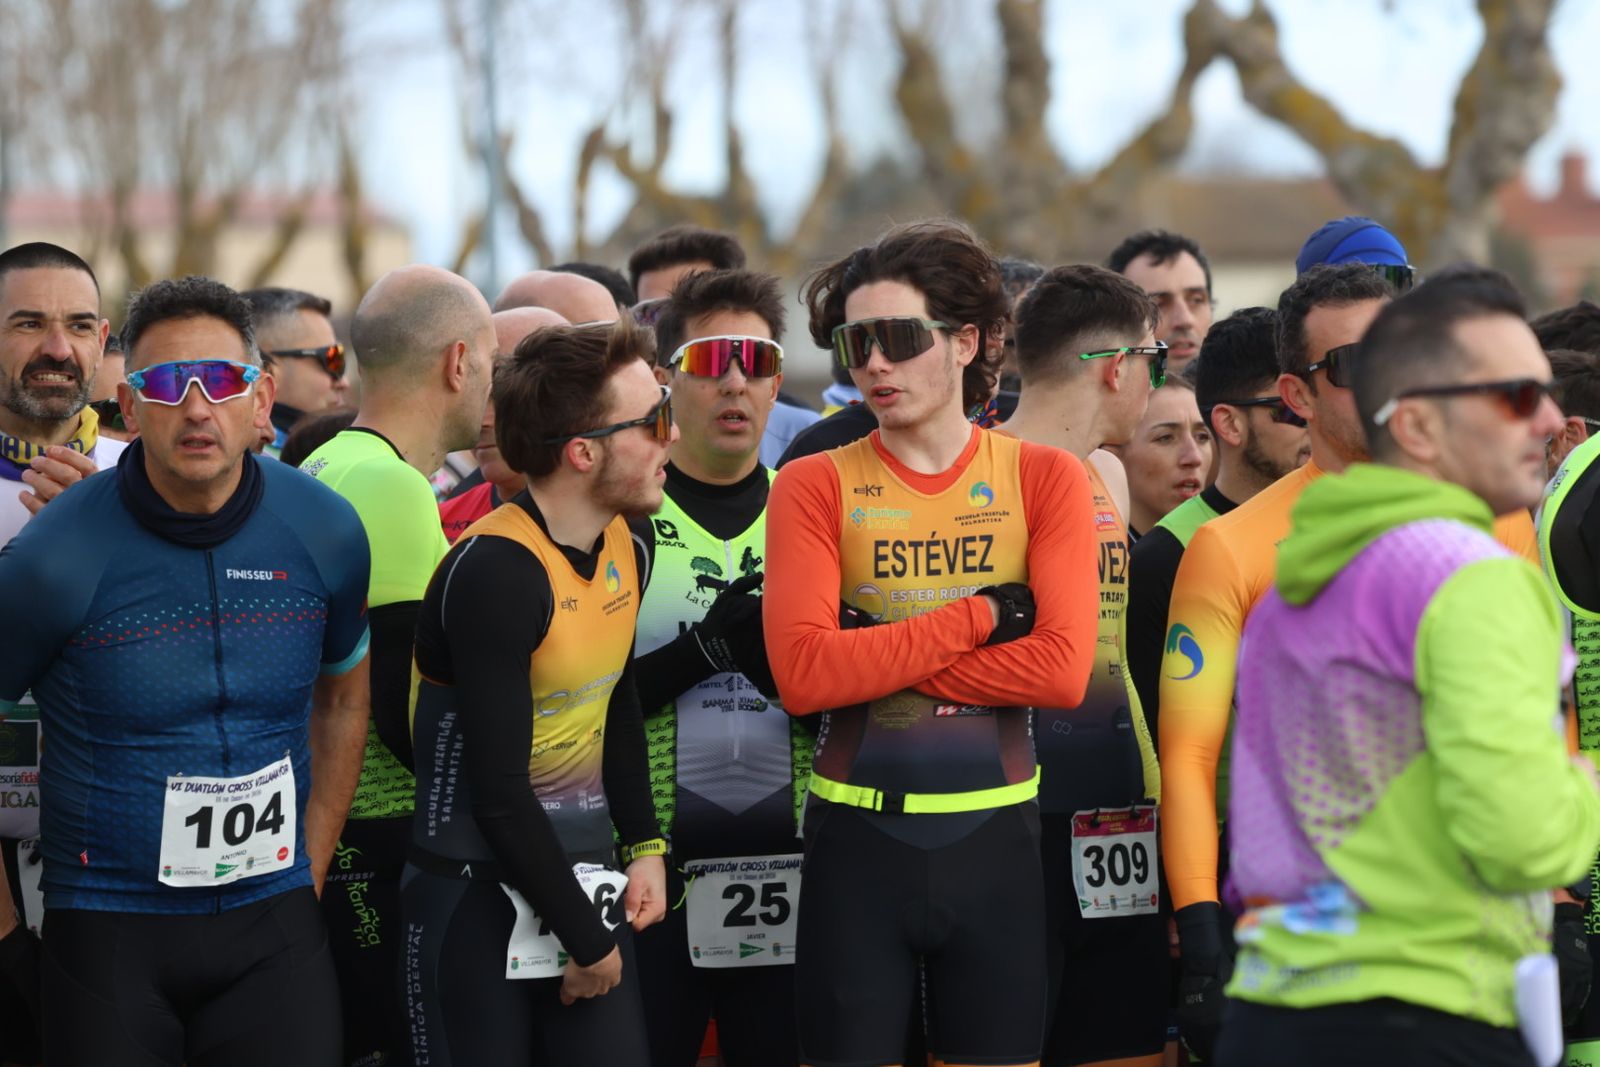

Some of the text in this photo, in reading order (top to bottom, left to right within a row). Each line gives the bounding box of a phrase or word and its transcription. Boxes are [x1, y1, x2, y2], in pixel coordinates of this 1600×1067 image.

[874, 531, 994, 579] ESTÉVEZ
[890, 588, 935, 602] ESTER
[171, 764, 289, 794] VI DUATLÓN CROSS VILLAMAYOR
[185, 790, 285, 849] 104
[428, 777, 442, 836] ESCUELA
[220, 849, 248, 861] ANTONIO
[740, 861, 767, 872] CROSS
[1083, 841, 1149, 888] 309
[722, 881, 791, 928] 25
[411, 925, 424, 993] DENTAL
